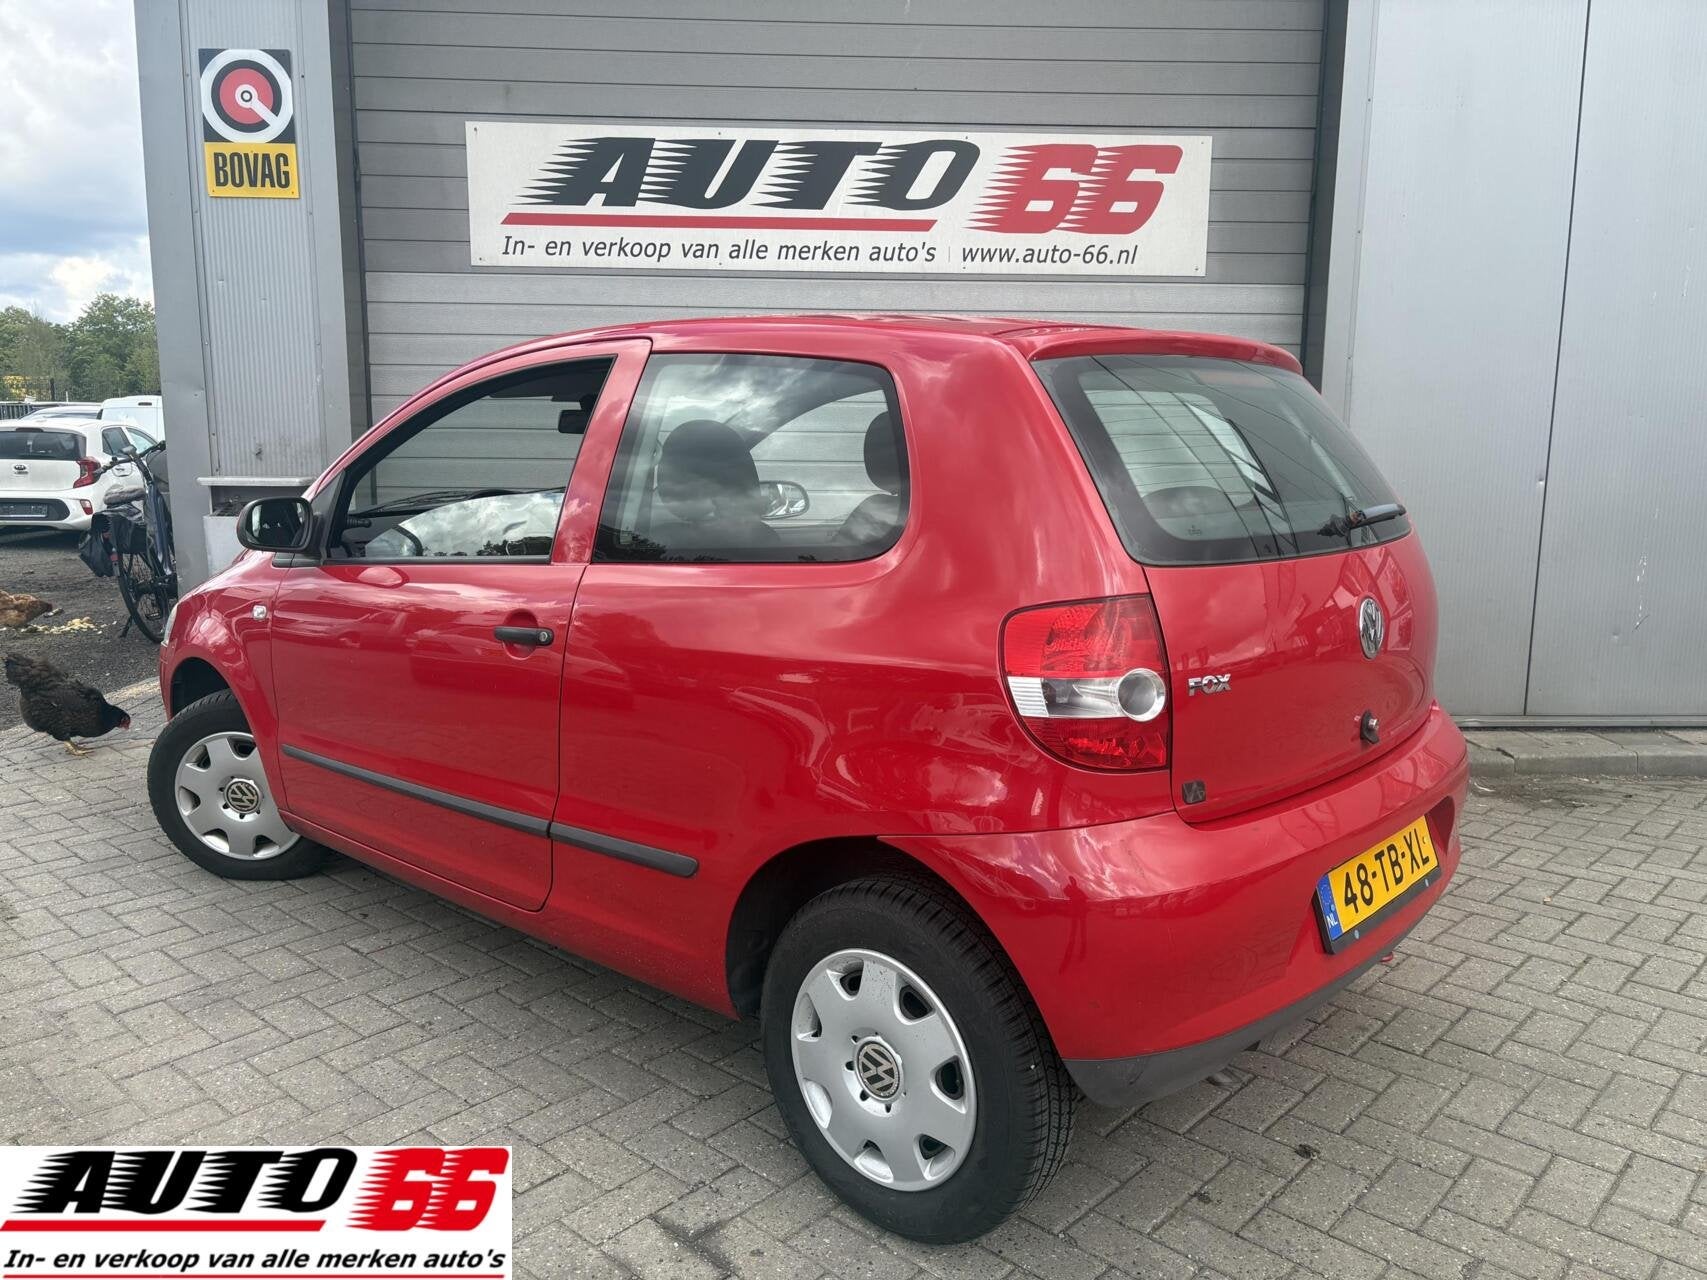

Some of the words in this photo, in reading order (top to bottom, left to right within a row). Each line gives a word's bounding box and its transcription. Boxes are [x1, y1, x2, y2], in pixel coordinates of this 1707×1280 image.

[213, 152, 291, 189] BOVAG
[510, 137, 981, 210] AUTO
[962, 143, 1183, 235] 66
[502, 236, 536, 256] In-
[545, 239, 572, 257] en
[582, 238, 672, 262] verkoop
[681, 241, 719, 260] van
[728, 240, 768, 261] alle
[777, 242, 859, 262] merken
[868, 243, 936, 263] auto's
[962, 245, 1138, 266] www.auto-66.nl
[1188, 673, 1232, 697] FOX
[1344, 828, 1430, 914] 48-TB-XL
[1326, 913, 1339, 928] NL
